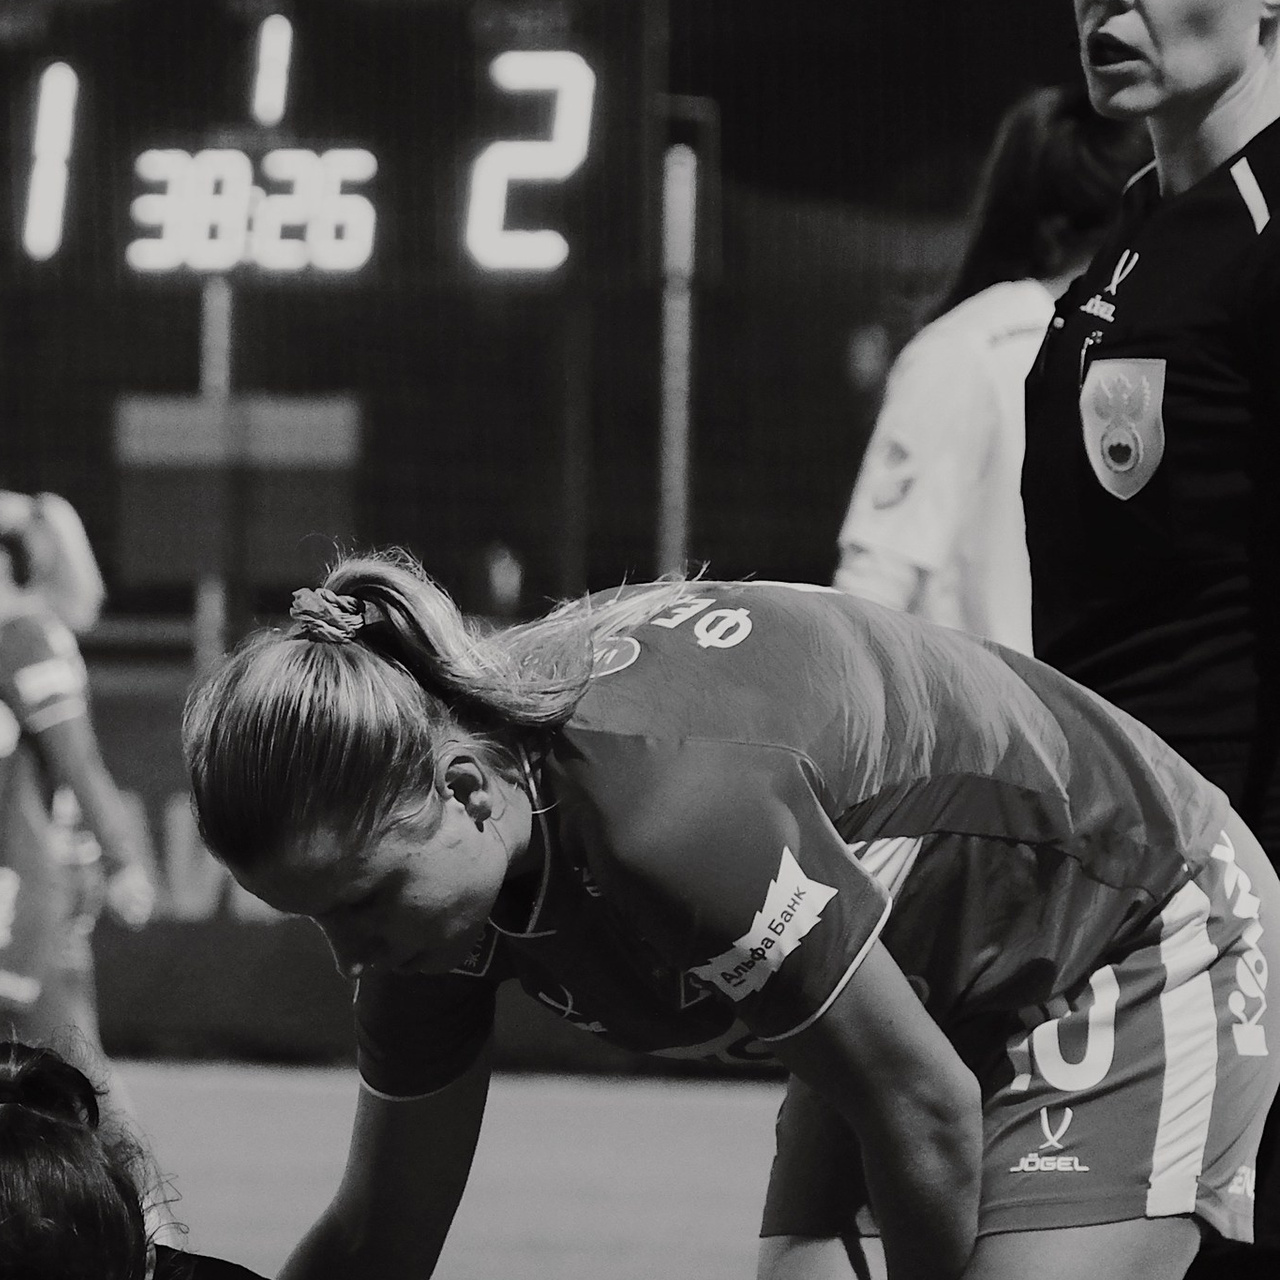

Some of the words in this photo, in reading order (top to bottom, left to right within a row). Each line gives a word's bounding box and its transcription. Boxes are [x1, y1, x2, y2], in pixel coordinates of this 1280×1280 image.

[253, 14, 292, 124] 1
[23, 62, 78, 258] 1
[465, 51, 596, 271] 2
[721, 937, 775, 984] Альфа
[768, 886, 807, 937] Банк
[1010, 1153, 1090, 1172] JÖGEL
